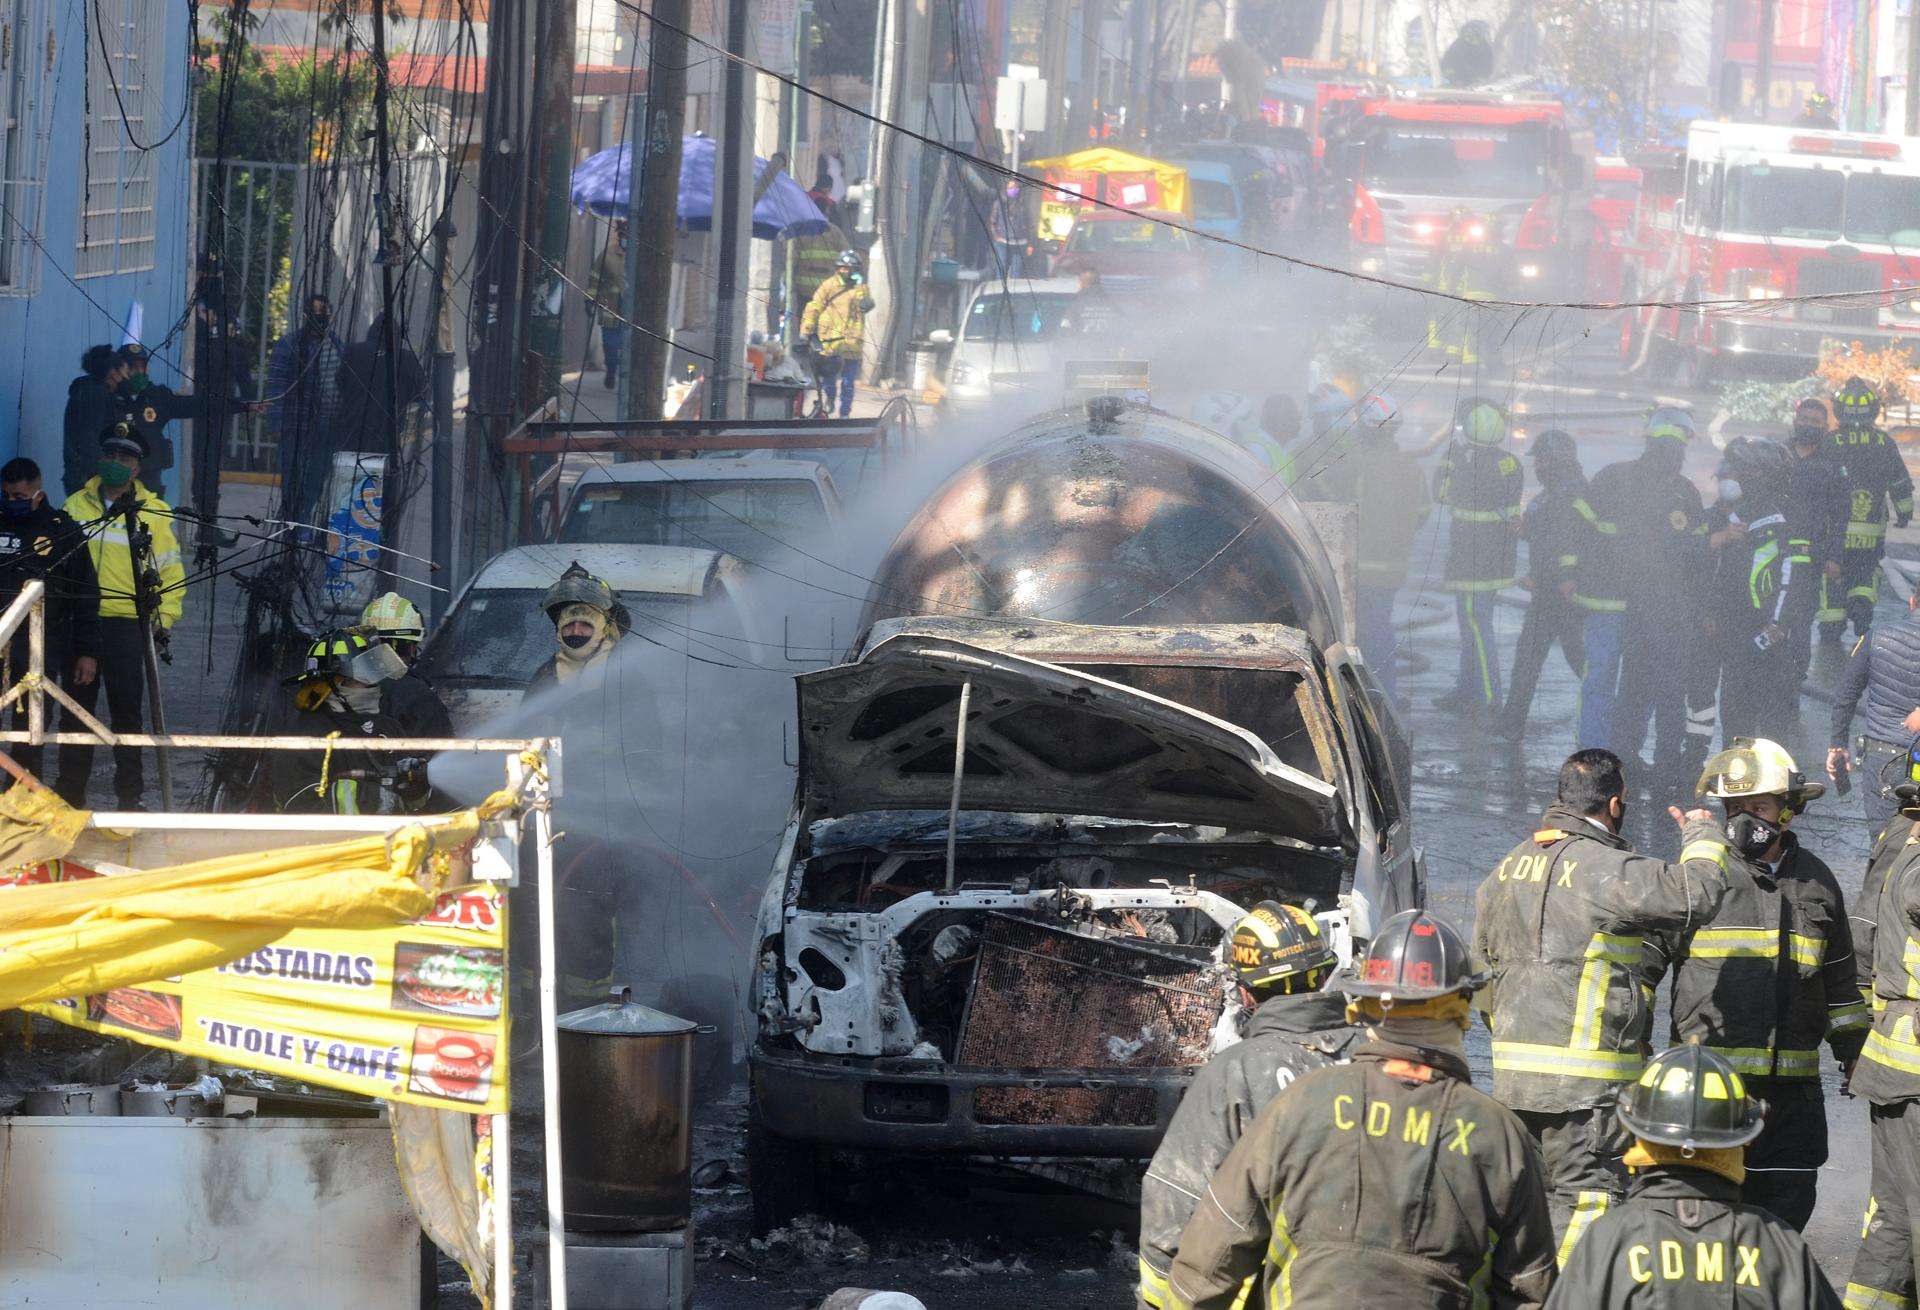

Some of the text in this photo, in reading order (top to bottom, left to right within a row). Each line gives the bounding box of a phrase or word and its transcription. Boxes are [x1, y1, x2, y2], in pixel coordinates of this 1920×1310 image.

[1834, 431, 1886, 447] CDMX
[1498, 854, 1578, 888] CDMX
[218, 945, 374, 987] OSTADAS
[1232, 944, 1261, 965] DMX
[303, 1038, 320, 1065] Y
[1334, 1094, 1476, 1156] CDMX
[1628, 1240, 1760, 1287] CDMX
